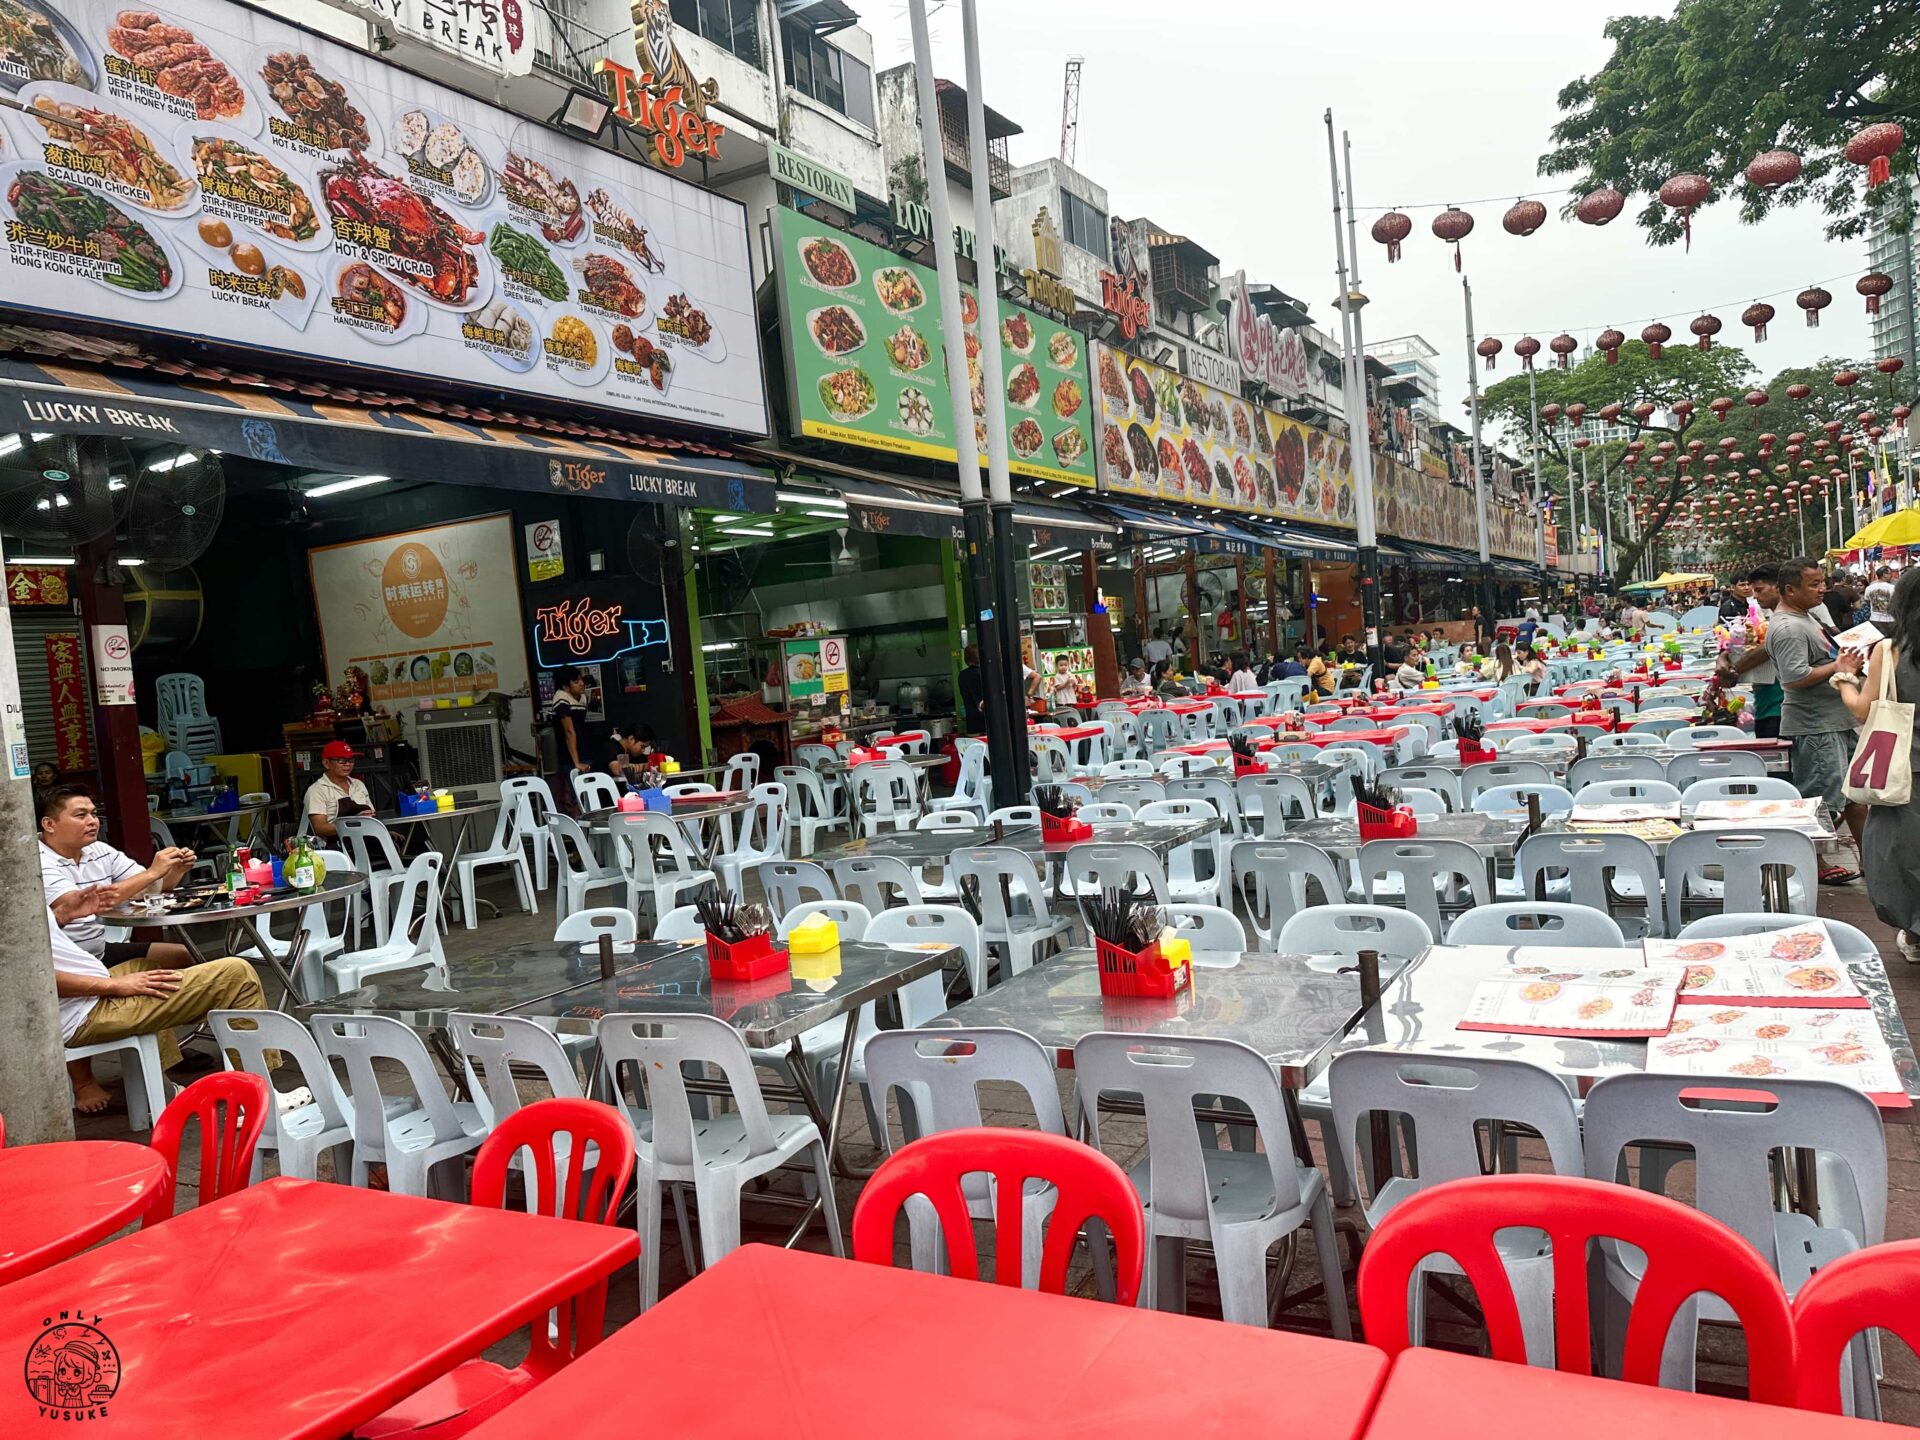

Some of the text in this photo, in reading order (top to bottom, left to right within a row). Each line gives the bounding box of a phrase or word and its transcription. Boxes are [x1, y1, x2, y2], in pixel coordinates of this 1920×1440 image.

[423, 11, 502, 62] BREAK
[0, 61, 29, 78] WITH
[105, 55, 156, 87] 蜜汁虾
[107, 76, 196, 110] DEEP FRIED PRAWN
[108, 87, 197, 120] WITH HONEY SAUCE
[598, 57, 725, 168] Tiger
[43, 143, 106, 177] 葱油鸡
[272, 137, 343, 166] HOT & SPICY LALA
[47, 167, 150, 201] SCALLION CHICKEN
[409, 175, 473, 202] GRILL OYSTERS WITH
[776, 150, 852, 204] RESTORAN
[410, 184, 436, 199] CHEESE
[201, 194, 290, 224] STIR-FRIED MEAT WITH
[202, 205, 264, 228] GREEN PEPPER
[508, 213, 532, 227] CHEESE
[893, 193, 932, 240] LOV
[5, 220, 101, 258] 芥兰炒牛肉
[331, 216, 393, 251] 香辣蟹
[595, 235, 623, 250] BBQ SQUID
[9, 243, 121, 274] STIR-FRIED BEEF WITH
[11, 255, 103, 281] HONG KONG KALE
[334, 240, 434, 277] HOT & SPICY CRAB
[208, 269, 273, 299] 时来运转
[502, 282, 535, 297] STIR-FRIED
[503, 289, 544, 306] GREEN BEANS
[211, 290, 271, 310] LUCKY BREAK
[1098, 270, 1150, 339] Tiger
[333, 315, 395, 335] HANDMADE TOFU
[658, 332, 676, 345] SALTED
[463, 340, 530, 361] SEAFOOD SPRING ROLL
[659, 339, 673, 350] FROG
[545, 354, 592, 372] PINEAPPLE FRIED
[546, 363, 560, 373] RICE
[1190, 348, 1239, 393] RESTORAN
[616, 373, 650, 386] OYSTER CAKE
[22, 399, 181, 434] LUCKY BREAK
[565, 463, 606, 491] Tiger
[629, 473, 698, 498] LUCKY BREAK
[870, 511, 890, 531] Tiger
[1090, 534, 1114, 550] Bamboo
[7, 572, 38, 599] 金
[537, 597, 622, 656] Tiger
